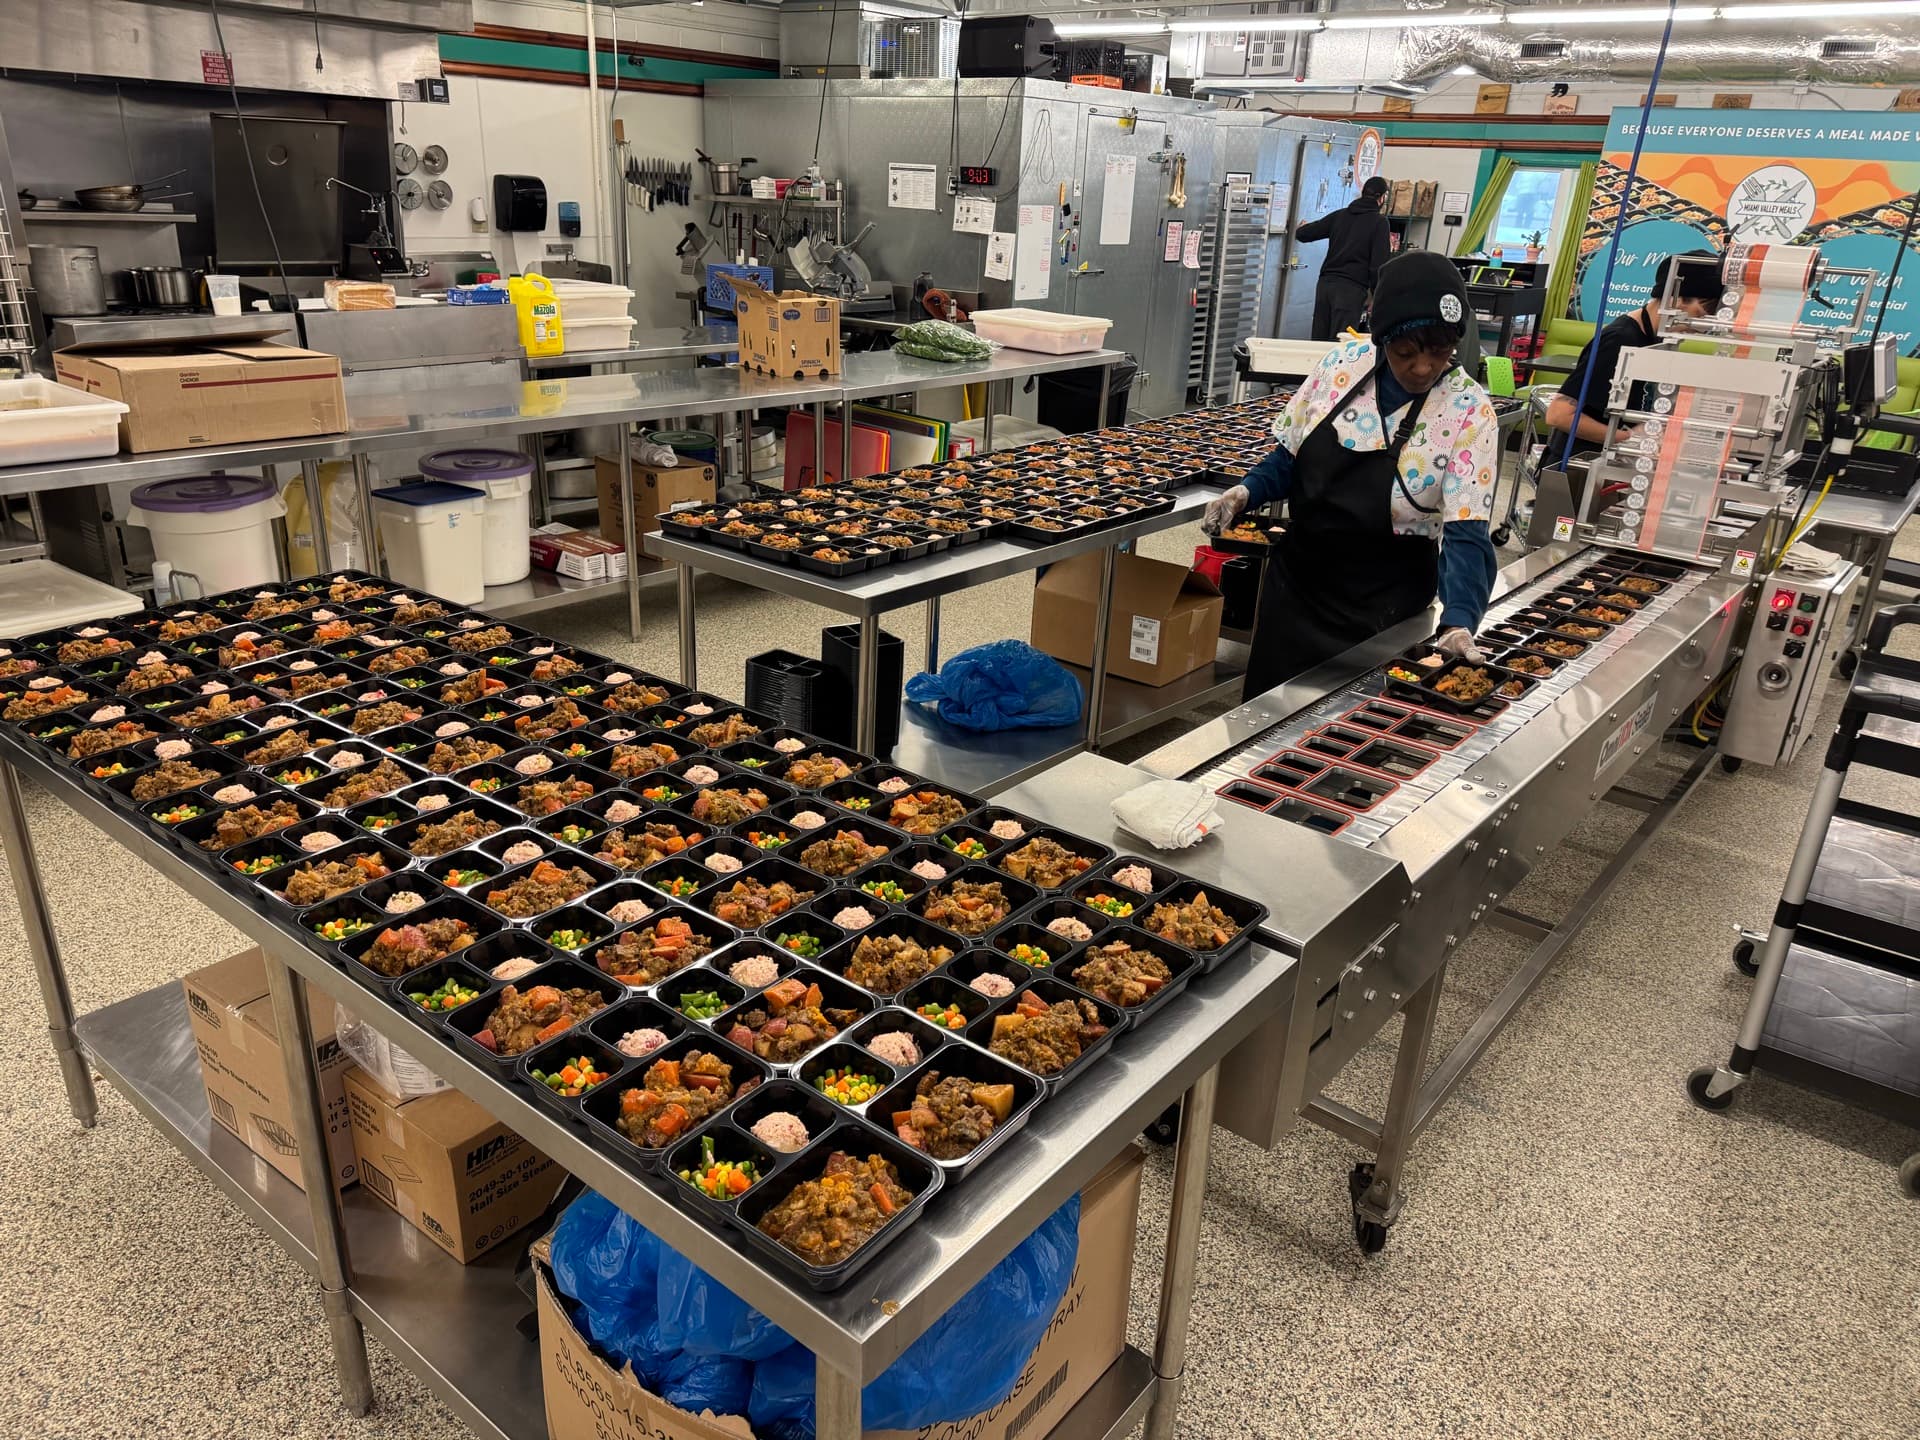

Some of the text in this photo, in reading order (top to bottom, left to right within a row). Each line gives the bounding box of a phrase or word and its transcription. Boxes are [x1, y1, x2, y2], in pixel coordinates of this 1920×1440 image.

[1677, 126, 1742, 137] EVERYONE
[1746, 127, 1811, 139] DESERVES
[1815, 129, 1824, 139] A
[1829, 129, 1865, 140] MEAL
[1869, 130, 1911, 141] MADE
[1743, 203, 1798, 215] MIAMI VALLEY MEALS
[533, 303, 556, 316] Mazola
[1832, 296, 1848, 305] an
[466, 1135, 504, 1170] HFA
[468, 1154, 536, 1203] 2049-30-100
[470, 1159, 556, 1215] Half Size Steam
[1047, 1285, 1087, 1341] TRAY
[559, 1336, 676, 1440] SL8565-15-3
